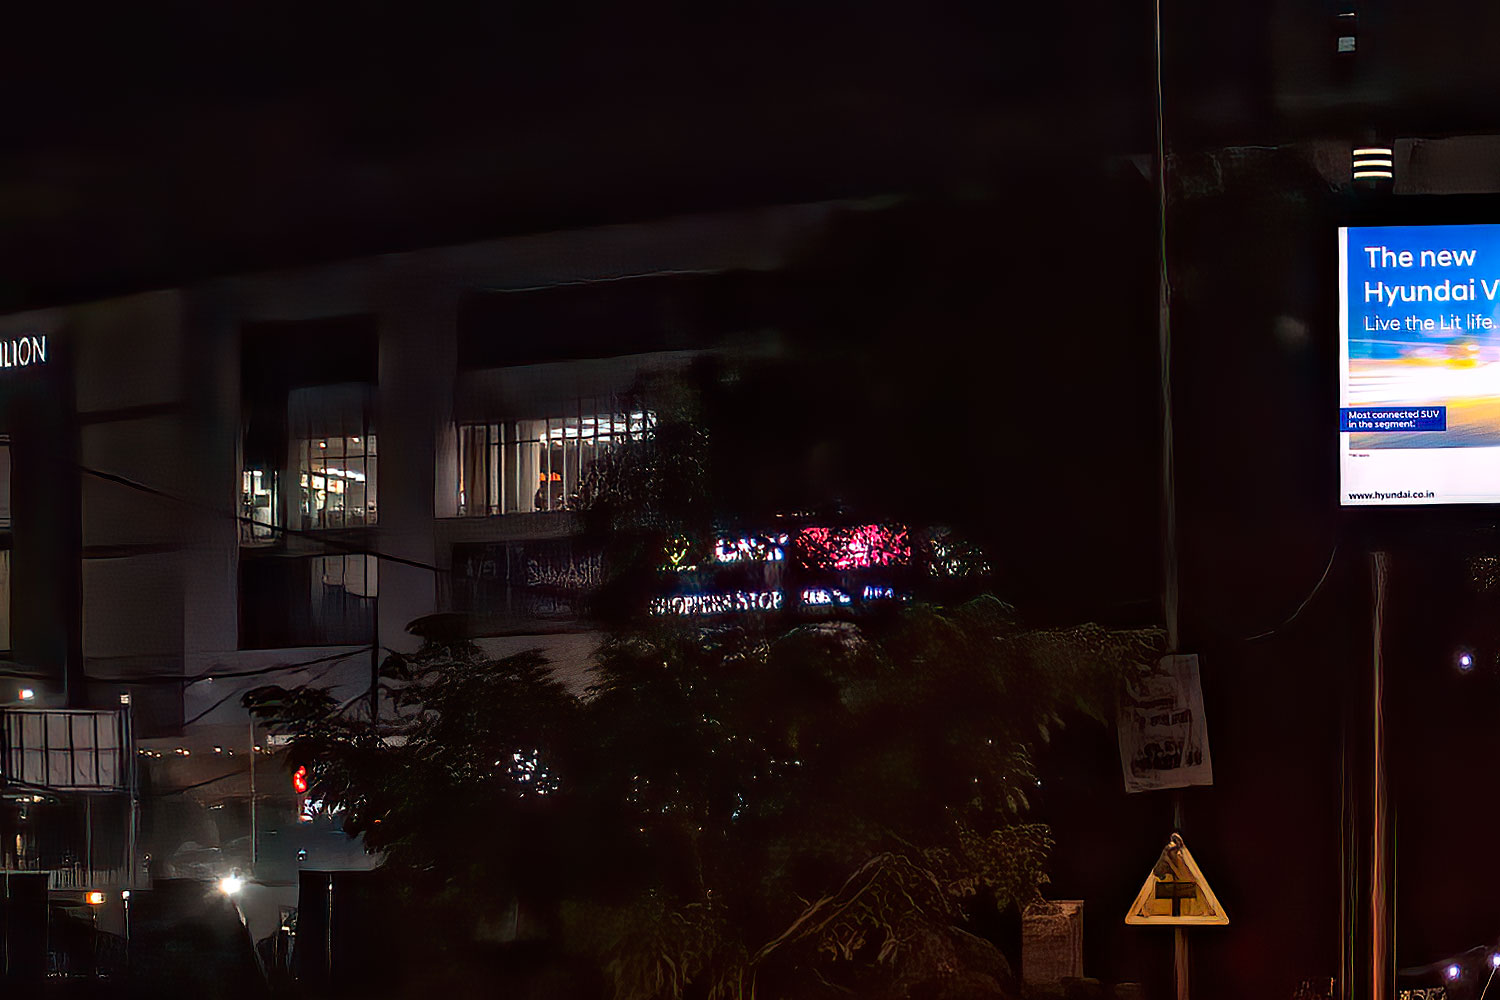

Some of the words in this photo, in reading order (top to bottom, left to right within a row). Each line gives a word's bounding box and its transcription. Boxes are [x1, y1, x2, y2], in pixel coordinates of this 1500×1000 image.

[1364, 246, 1413, 268] The
[1420, 249, 1477, 267] new
[1364, 278, 1475, 307] Hyundai
[1364, 315, 1401, 331] Live
[1405, 315, 1435, 331] the
[1440, 314, 1462, 331] Lit
[1467, 313, 1497, 330] life.
[1348, 411, 1371, 419] Most
[1371, 410, 1419, 419] connected
[1420, 410, 1440, 418] SUV
[1348, 420, 1357, 429] in
[1358, 420, 1373, 429] the
[1348, 490, 1435, 501] www.hyundai.co.in
